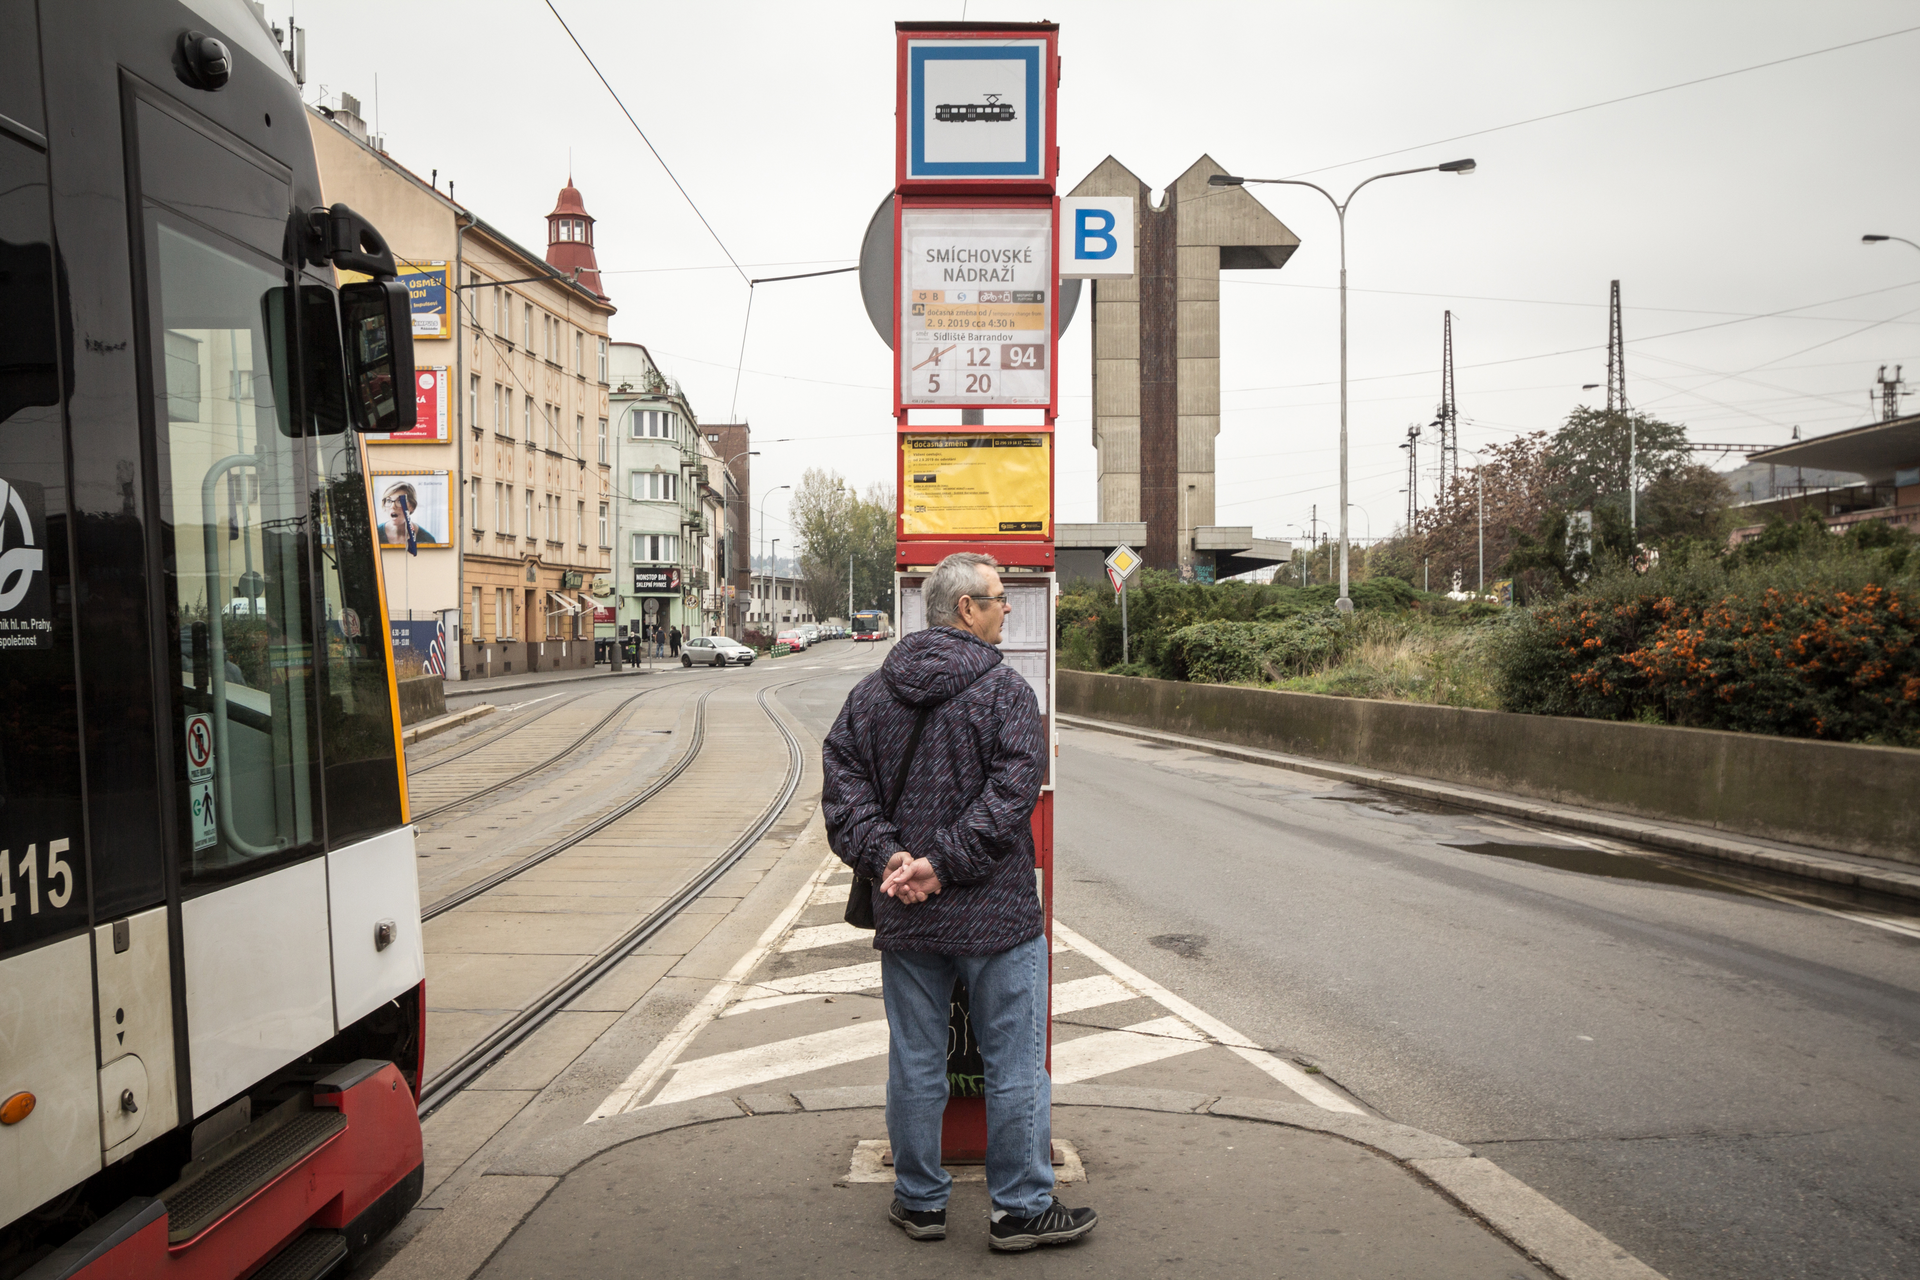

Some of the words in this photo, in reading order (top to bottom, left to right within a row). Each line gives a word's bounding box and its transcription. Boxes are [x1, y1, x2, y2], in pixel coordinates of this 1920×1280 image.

[1074, 208, 1118, 261] B
[926, 245, 1033, 263] SMÍCHOVSKÉ
[943, 264, 1015, 282] NÁDRAŽÍ
[932, 292, 939, 301] B
[927, 308, 954, 316] dočasná
[927, 319, 935, 328] 2.
[937, 319, 946, 328] 9.
[948, 319, 970, 328] 2019
[988, 319, 1008, 328] 4:30
[1009, 319, 1015, 328] h
[933, 332, 966, 341] Sídliště
[968, 333, 1014, 341] Barrandov
[928, 347, 942, 367] 4
[966, 347, 991, 367] 12
[1009, 346, 1037, 367] 94
[928, 373, 941, 393] 5
[965, 373, 992, 393] 20
[913, 440, 944, 448] dočasná
[944, 439, 968, 448] změna
[636, 573, 658, 581] NONSTOP
[20, 620, 30, 630] m.
[30, 618, 53, 633] Prahy,
